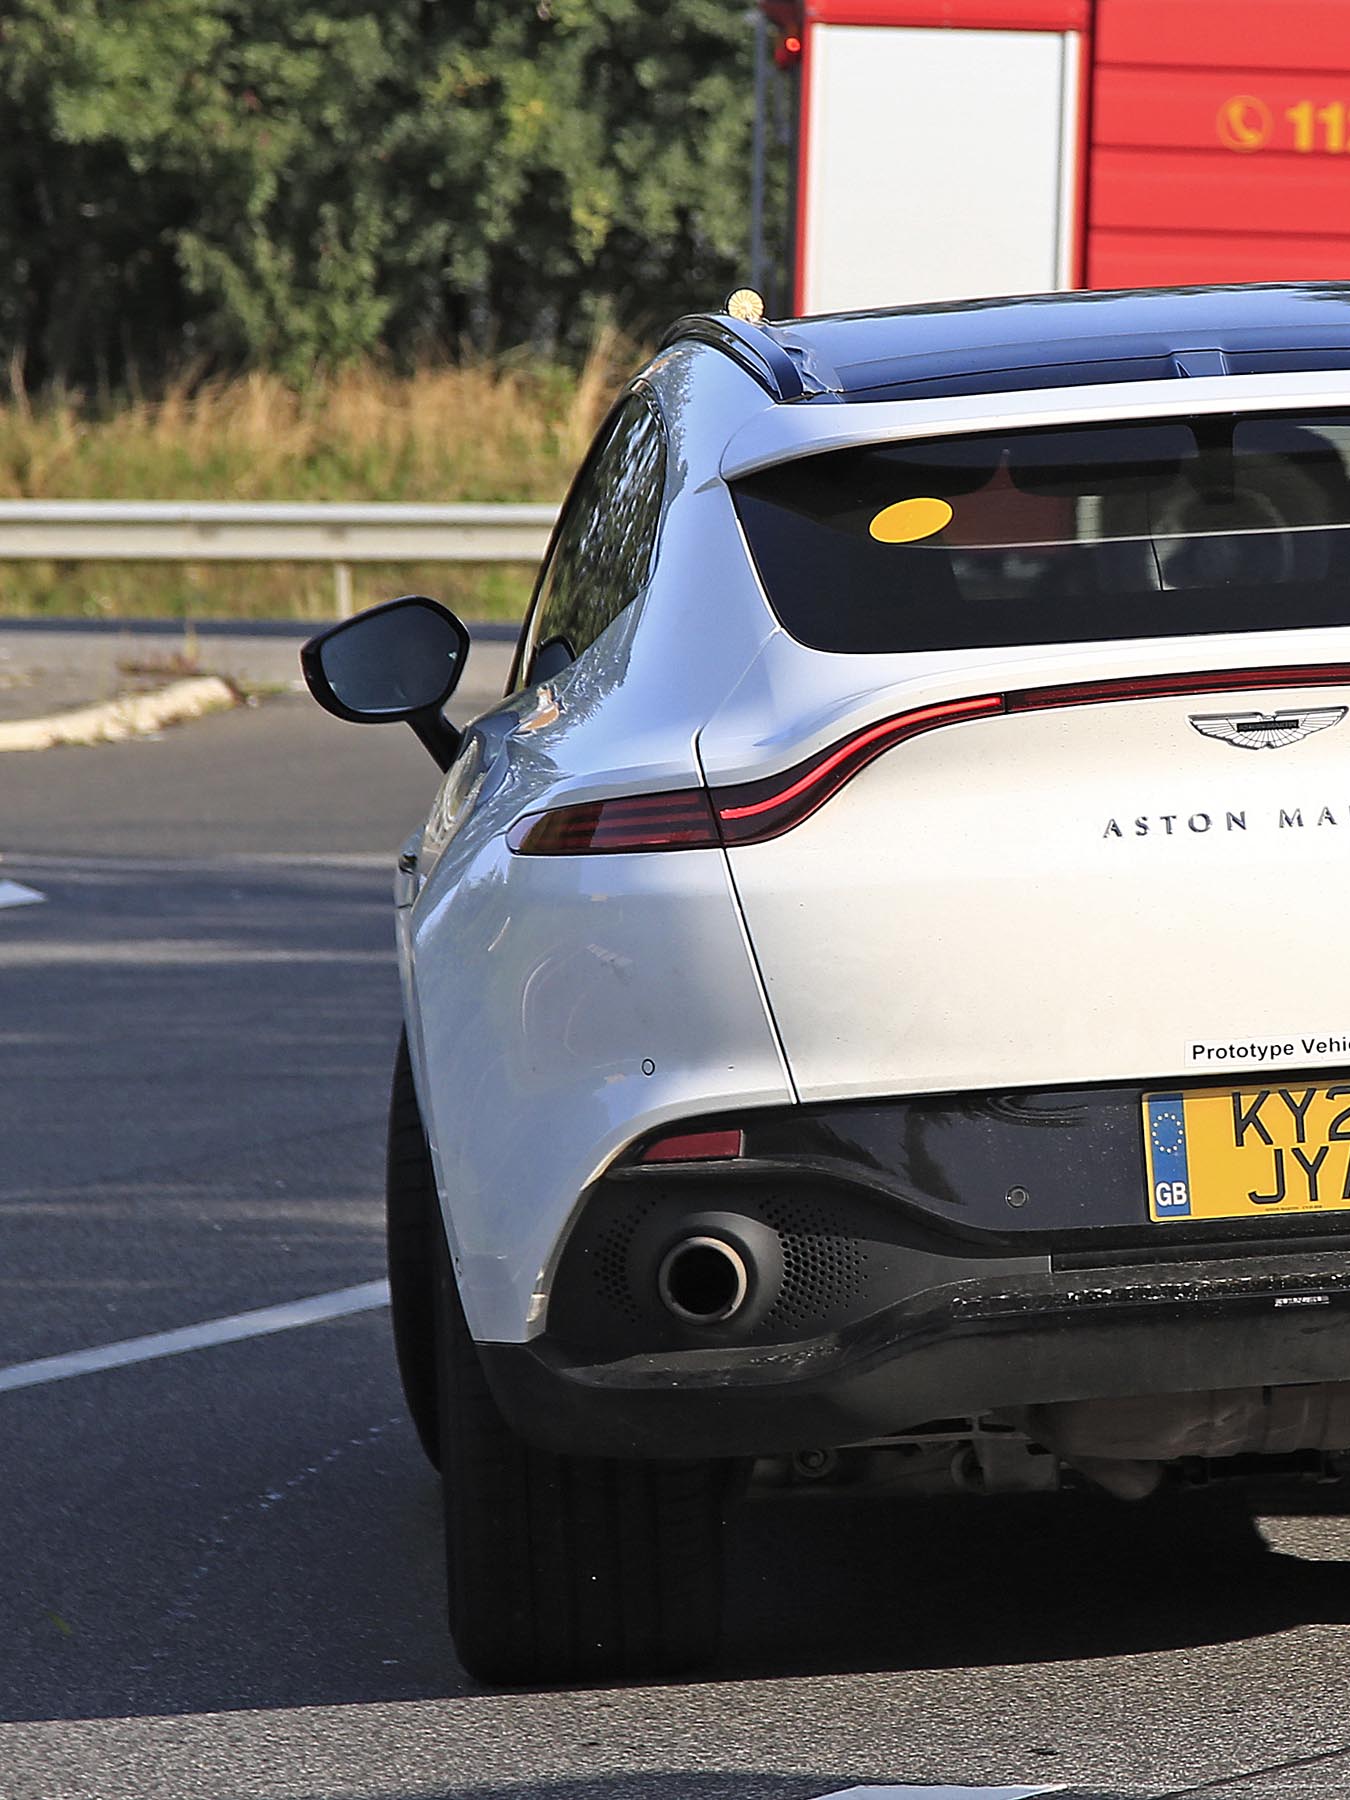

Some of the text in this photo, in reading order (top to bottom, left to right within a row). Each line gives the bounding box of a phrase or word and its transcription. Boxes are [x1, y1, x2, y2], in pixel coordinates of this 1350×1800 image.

[1103, 811, 1247, 839] ASTON
[1192, 1041, 1294, 1061] Prototype
[1155, 1181, 1188, 1207] GB
